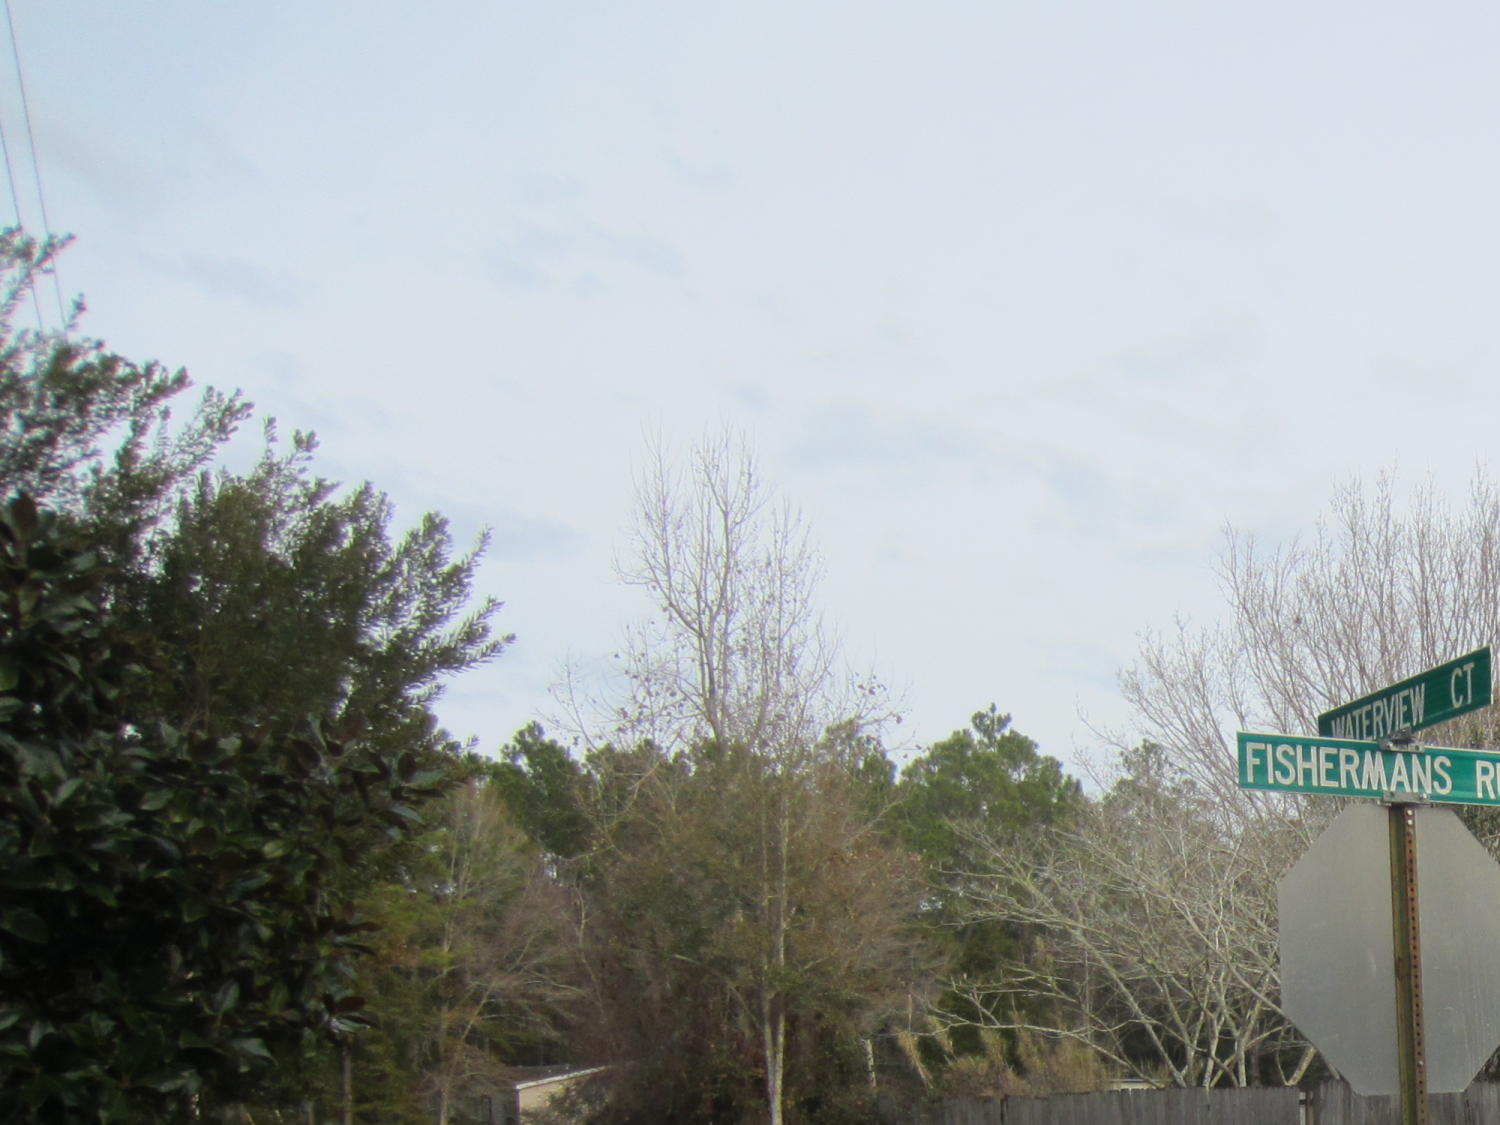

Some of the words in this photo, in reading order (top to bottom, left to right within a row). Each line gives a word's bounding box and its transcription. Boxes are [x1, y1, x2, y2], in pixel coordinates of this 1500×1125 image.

[1331, 683, 1426, 741] WATERVIEW
[1451, 662, 1475, 709] CT
[1246, 742, 1452, 795] FISHERMANS
